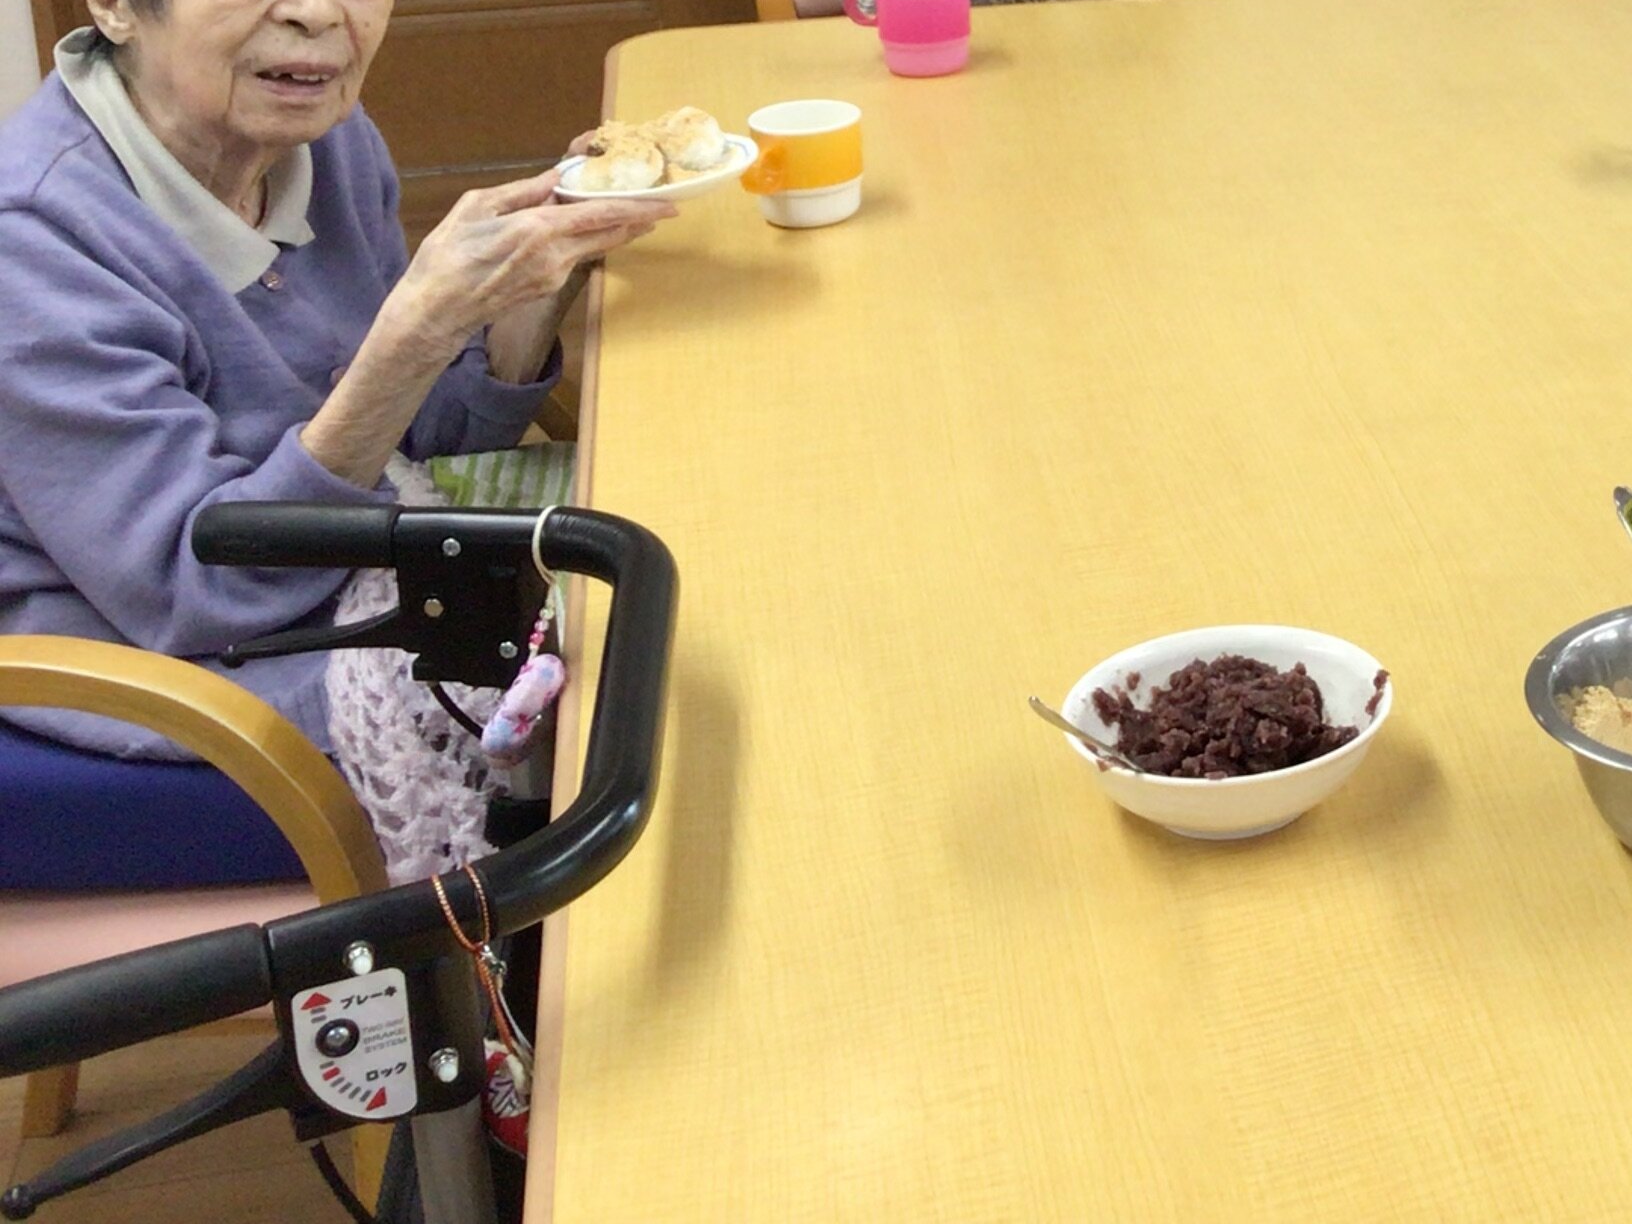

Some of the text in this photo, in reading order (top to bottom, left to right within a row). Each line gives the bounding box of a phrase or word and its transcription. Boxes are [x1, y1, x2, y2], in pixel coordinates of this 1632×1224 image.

[340, 986, 397, 1009] ブレーキ
[363, 1027, 405, 1044] BRAKE
[364, 1036, 407, 1053] SYSTEM
[366, 1062, 407, 1081] ロック
